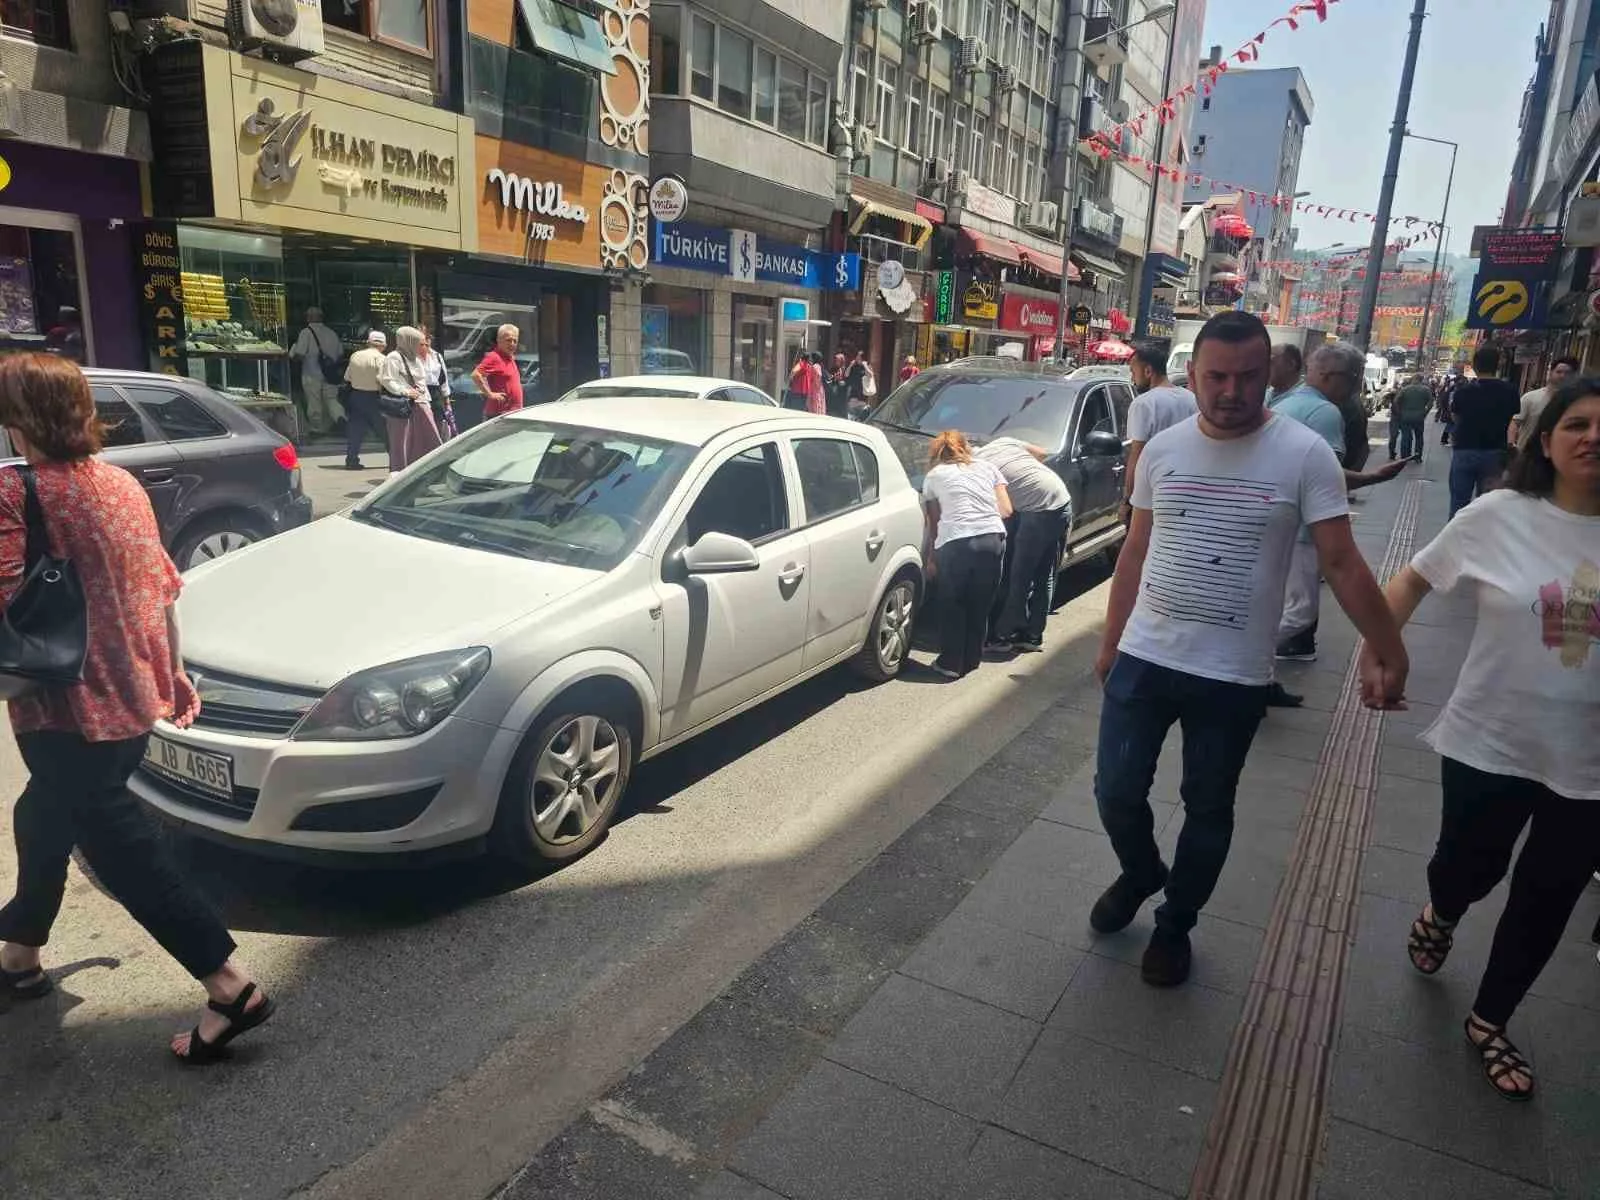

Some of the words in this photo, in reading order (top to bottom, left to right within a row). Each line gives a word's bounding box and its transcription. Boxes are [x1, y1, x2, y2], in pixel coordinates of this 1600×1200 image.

[311, 124, 375, 168] İLHAN
[487, 168, 589, 223] Milka
[144, 231, 174, 249] DÖVİZ
[529, 221, 555, 240] 1983
[142, 251, 179, 269] BÜROSU
[661, 229, 728, 263] TÜRKİYE
[754, 251, 808, 278] BANKASI
[186, 751, 228, 788] 4665
